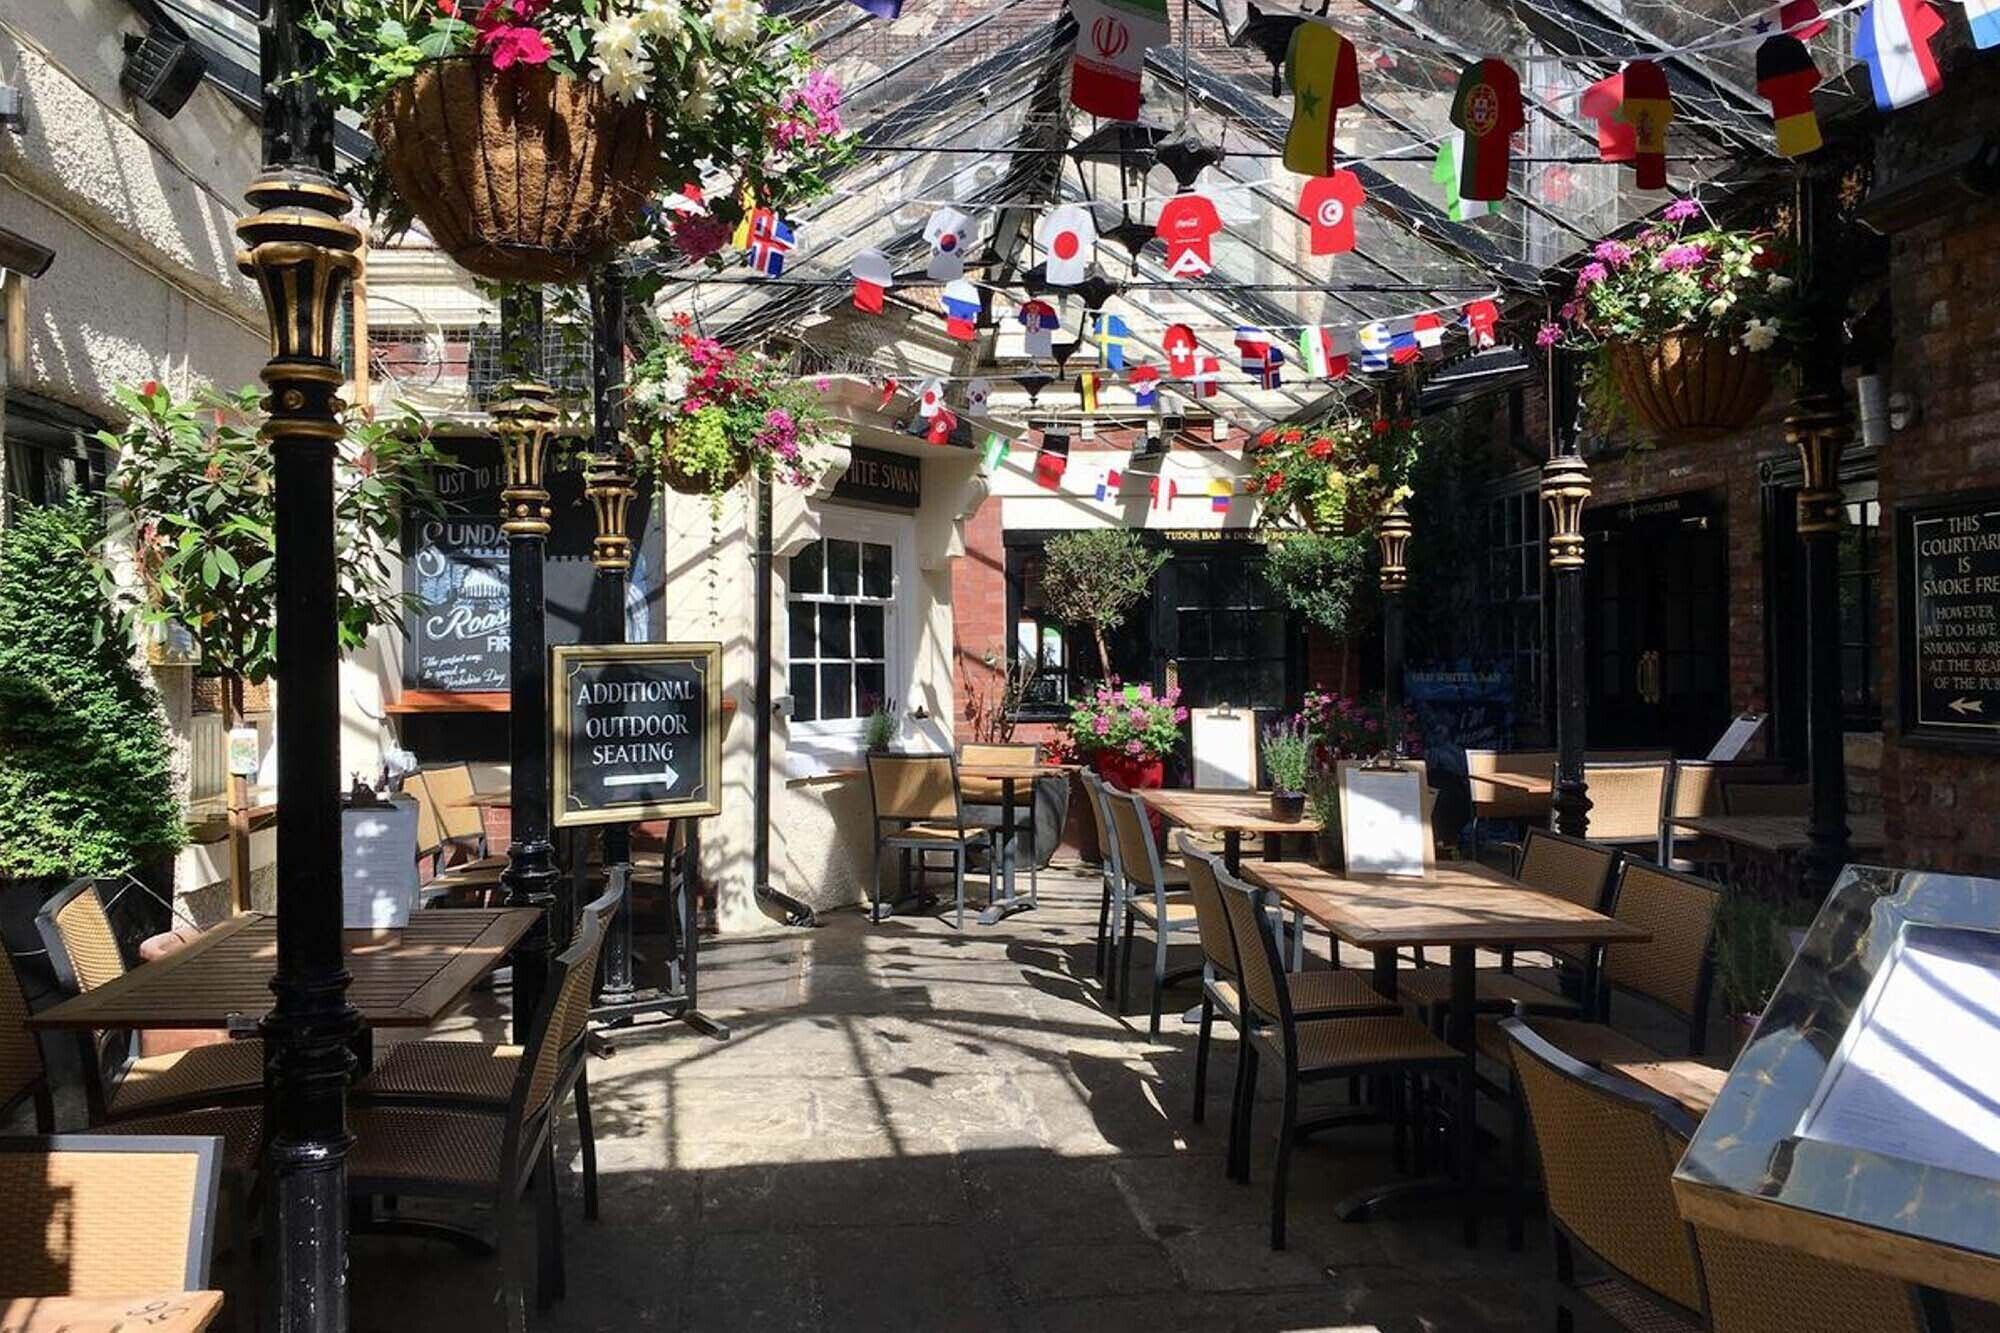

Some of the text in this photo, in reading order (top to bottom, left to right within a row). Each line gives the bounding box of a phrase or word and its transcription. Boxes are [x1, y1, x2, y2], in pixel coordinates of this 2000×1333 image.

[439, 470, 466, 494] UST
[844, 457, 919, 494] HITE SWAN
[1948, 514, 1981, 533] THIS
[1164, 531, 1200, 541] TUDOR
[1202, 531, 1221, 541] BAR
[1957, 556, 1971, 574] IS
[1922, 577, 1972, 597] SMOKE
[1936, 604, 1996, 620] HOWEVER
[1922, 622, 1996, 638] WE DO HAVE
[1923, 641, 1976, 656] SMOKING
[1928, 658, 1944, 673] AT
[1947, 658, 1971, 673] THE
[1933, 676, 1950, 689] OF
[1952, 676, 1975, 690] THE
[576, 680, 695, 706] ADDITIONAL
[586, 714, 689, 739] OUTDOOR
[592, 742, 674, 765] SEATING
